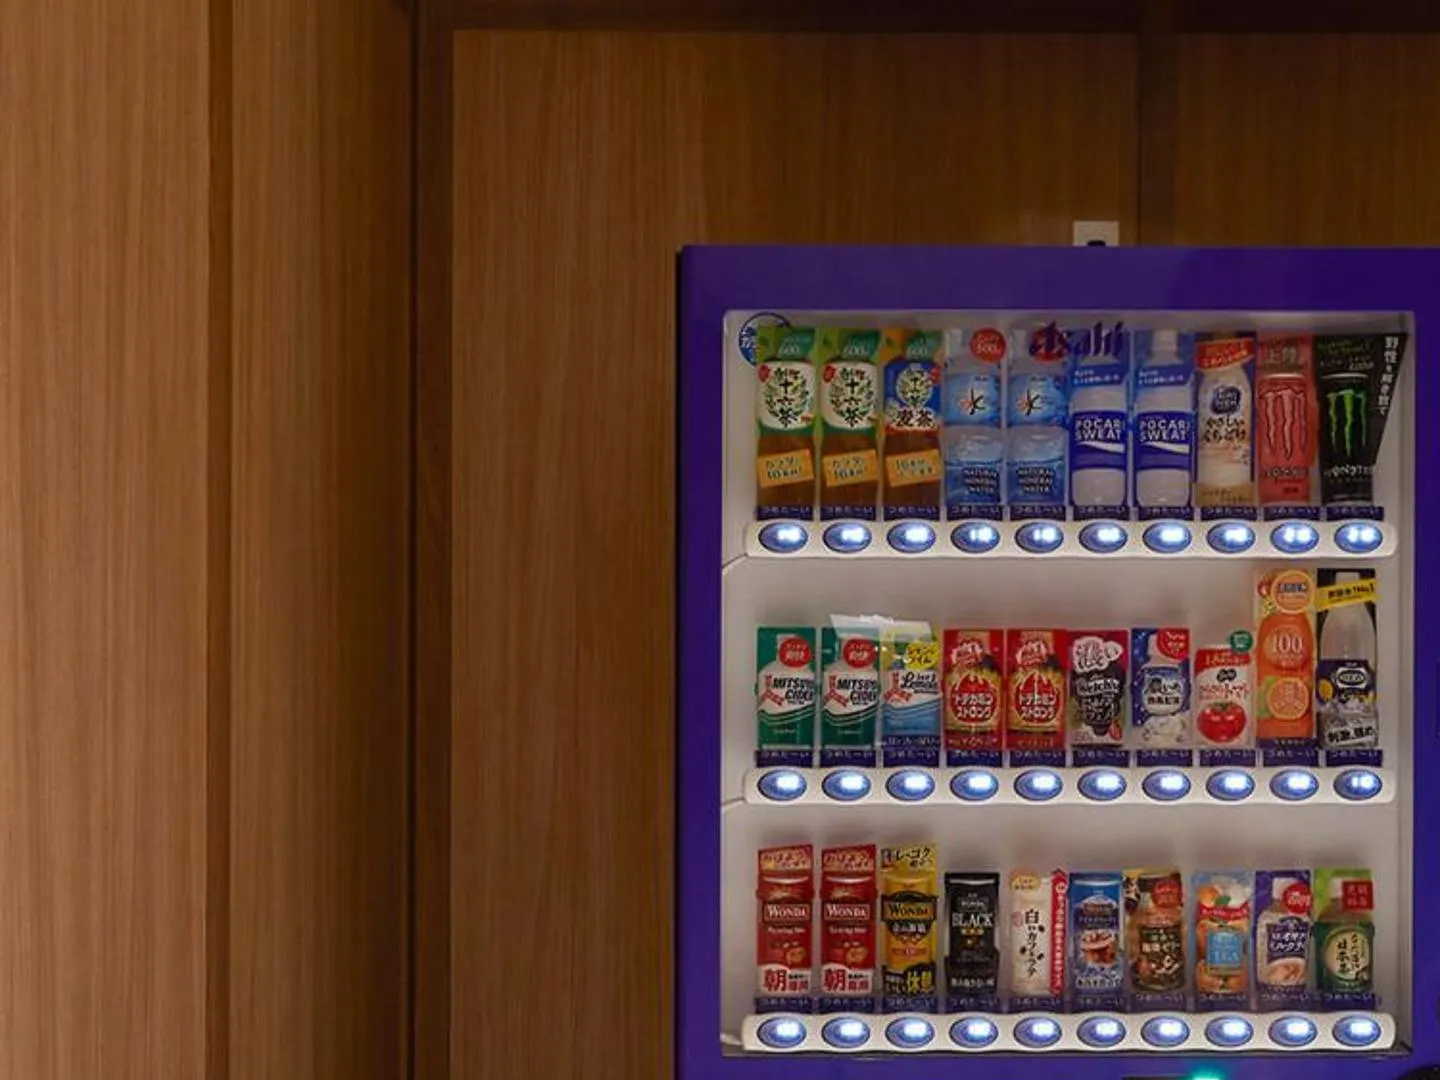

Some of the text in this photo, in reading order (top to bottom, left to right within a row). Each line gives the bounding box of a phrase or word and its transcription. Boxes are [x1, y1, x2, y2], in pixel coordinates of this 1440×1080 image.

[1075, 418, 1125, 430] POCARI
[1139, 419, 1189, 431] POCARI
[1075, 429, 1122, 441] SWEAT
[1139, 430, 1186, 442] SWEAT
[767, 903, 806, 918] WONDA
[827, 903, 867, 918] WONDA
[889, 902, 929, 916] WONDA
[951, 913, 993, 927] BLACK
[764, 969, 787, 992] 朝
[825, 969, 847, 992] 朝
